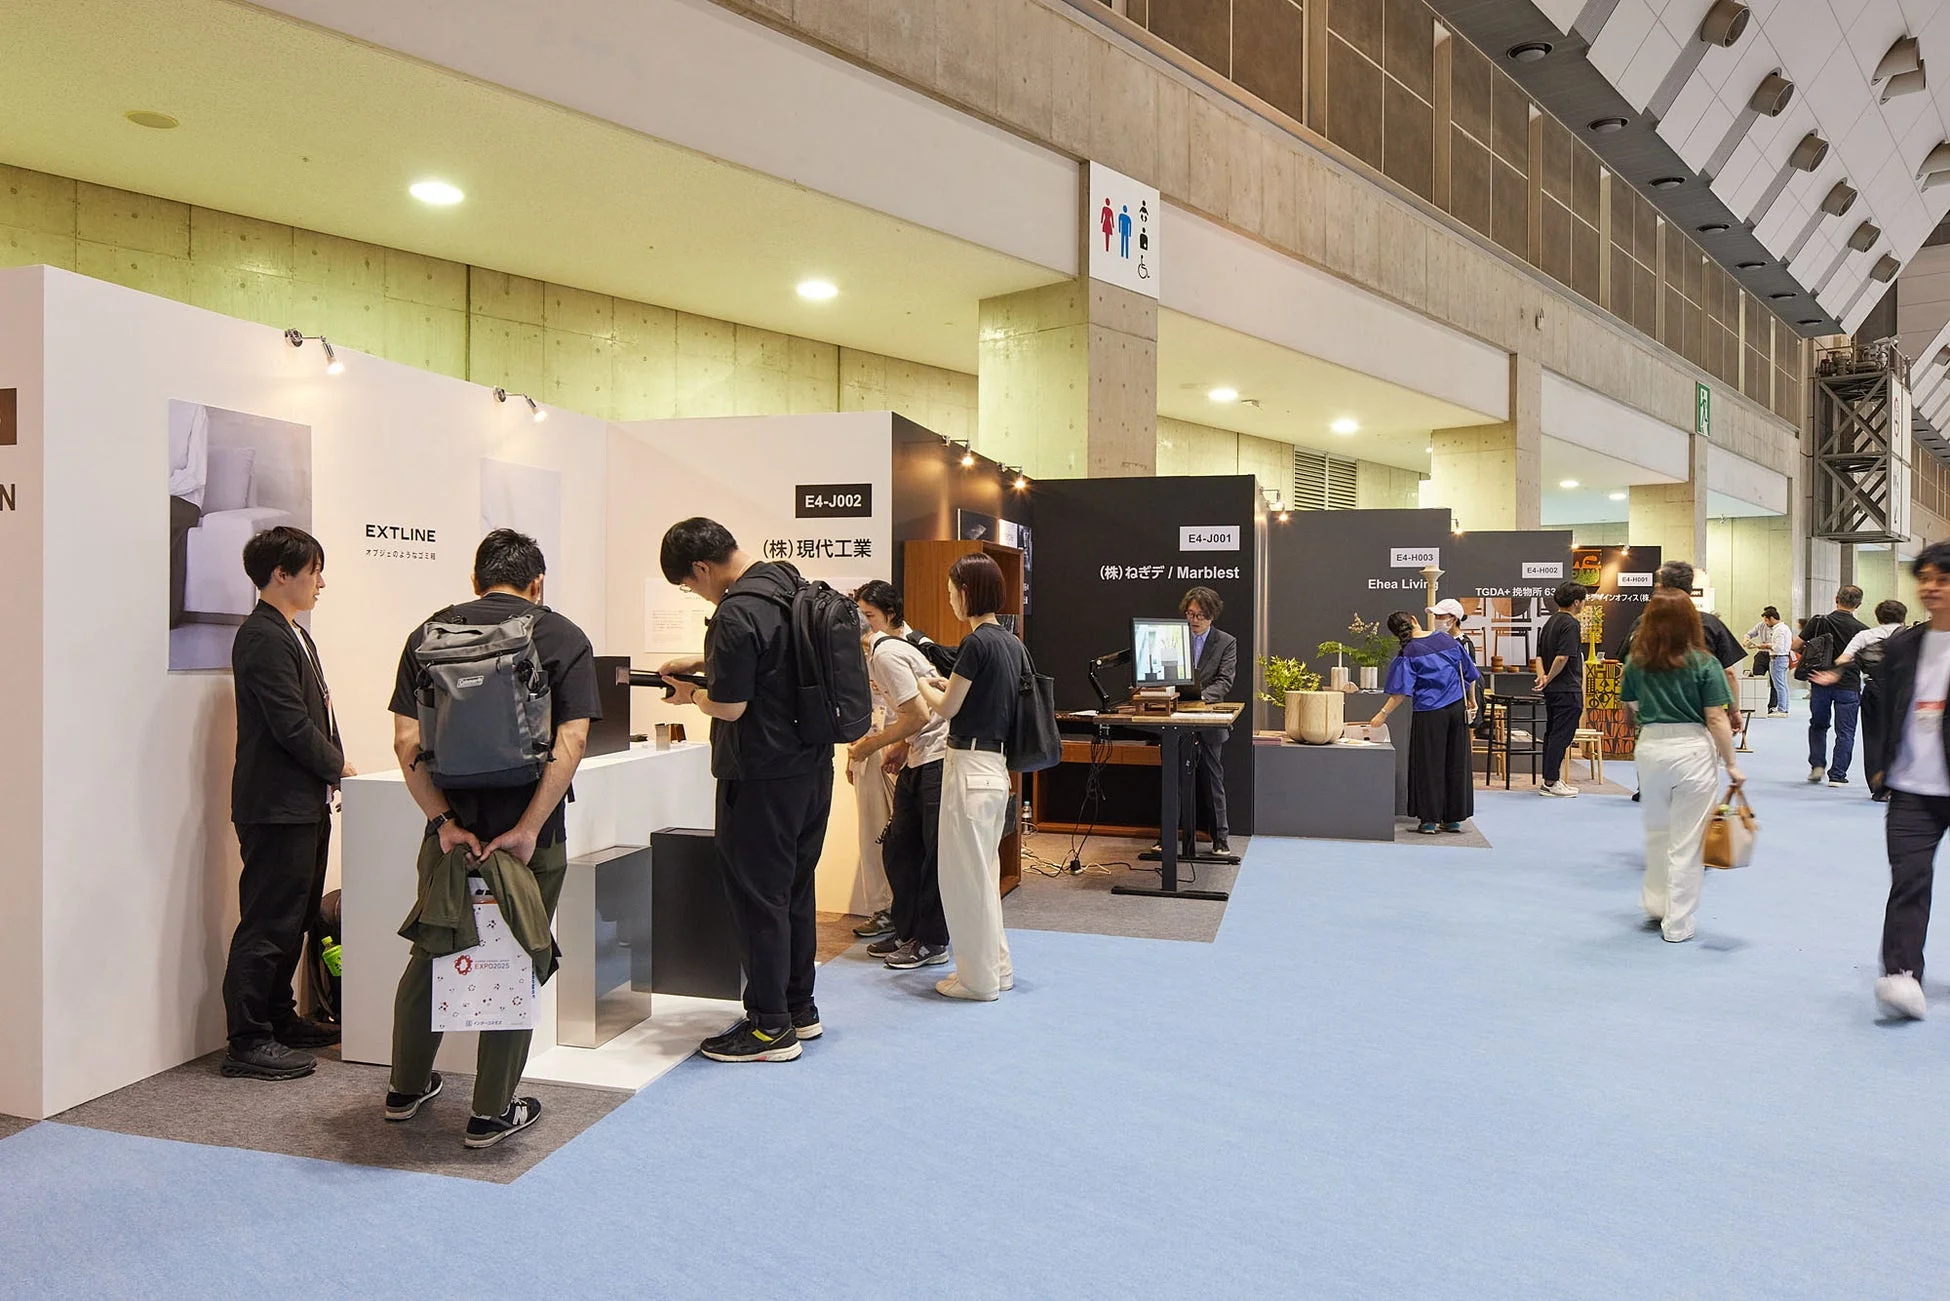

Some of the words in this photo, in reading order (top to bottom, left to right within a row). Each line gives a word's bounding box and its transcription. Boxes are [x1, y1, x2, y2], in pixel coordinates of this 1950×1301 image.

[805, 494, 862, 508] E4-J002
[365, 524, 436, 542] EXTLINE
[1188, 533, 1231, 543] E4-J001
[763, 538, 872, 559] (株)現代工業
[1396, 554, 1434, 562] E4-H003
[1177, 566, 1240, 579] Marblest
[1368, 579, 1398, 590] Ehea
[1475, 587, 1511, 597] TGDA+
